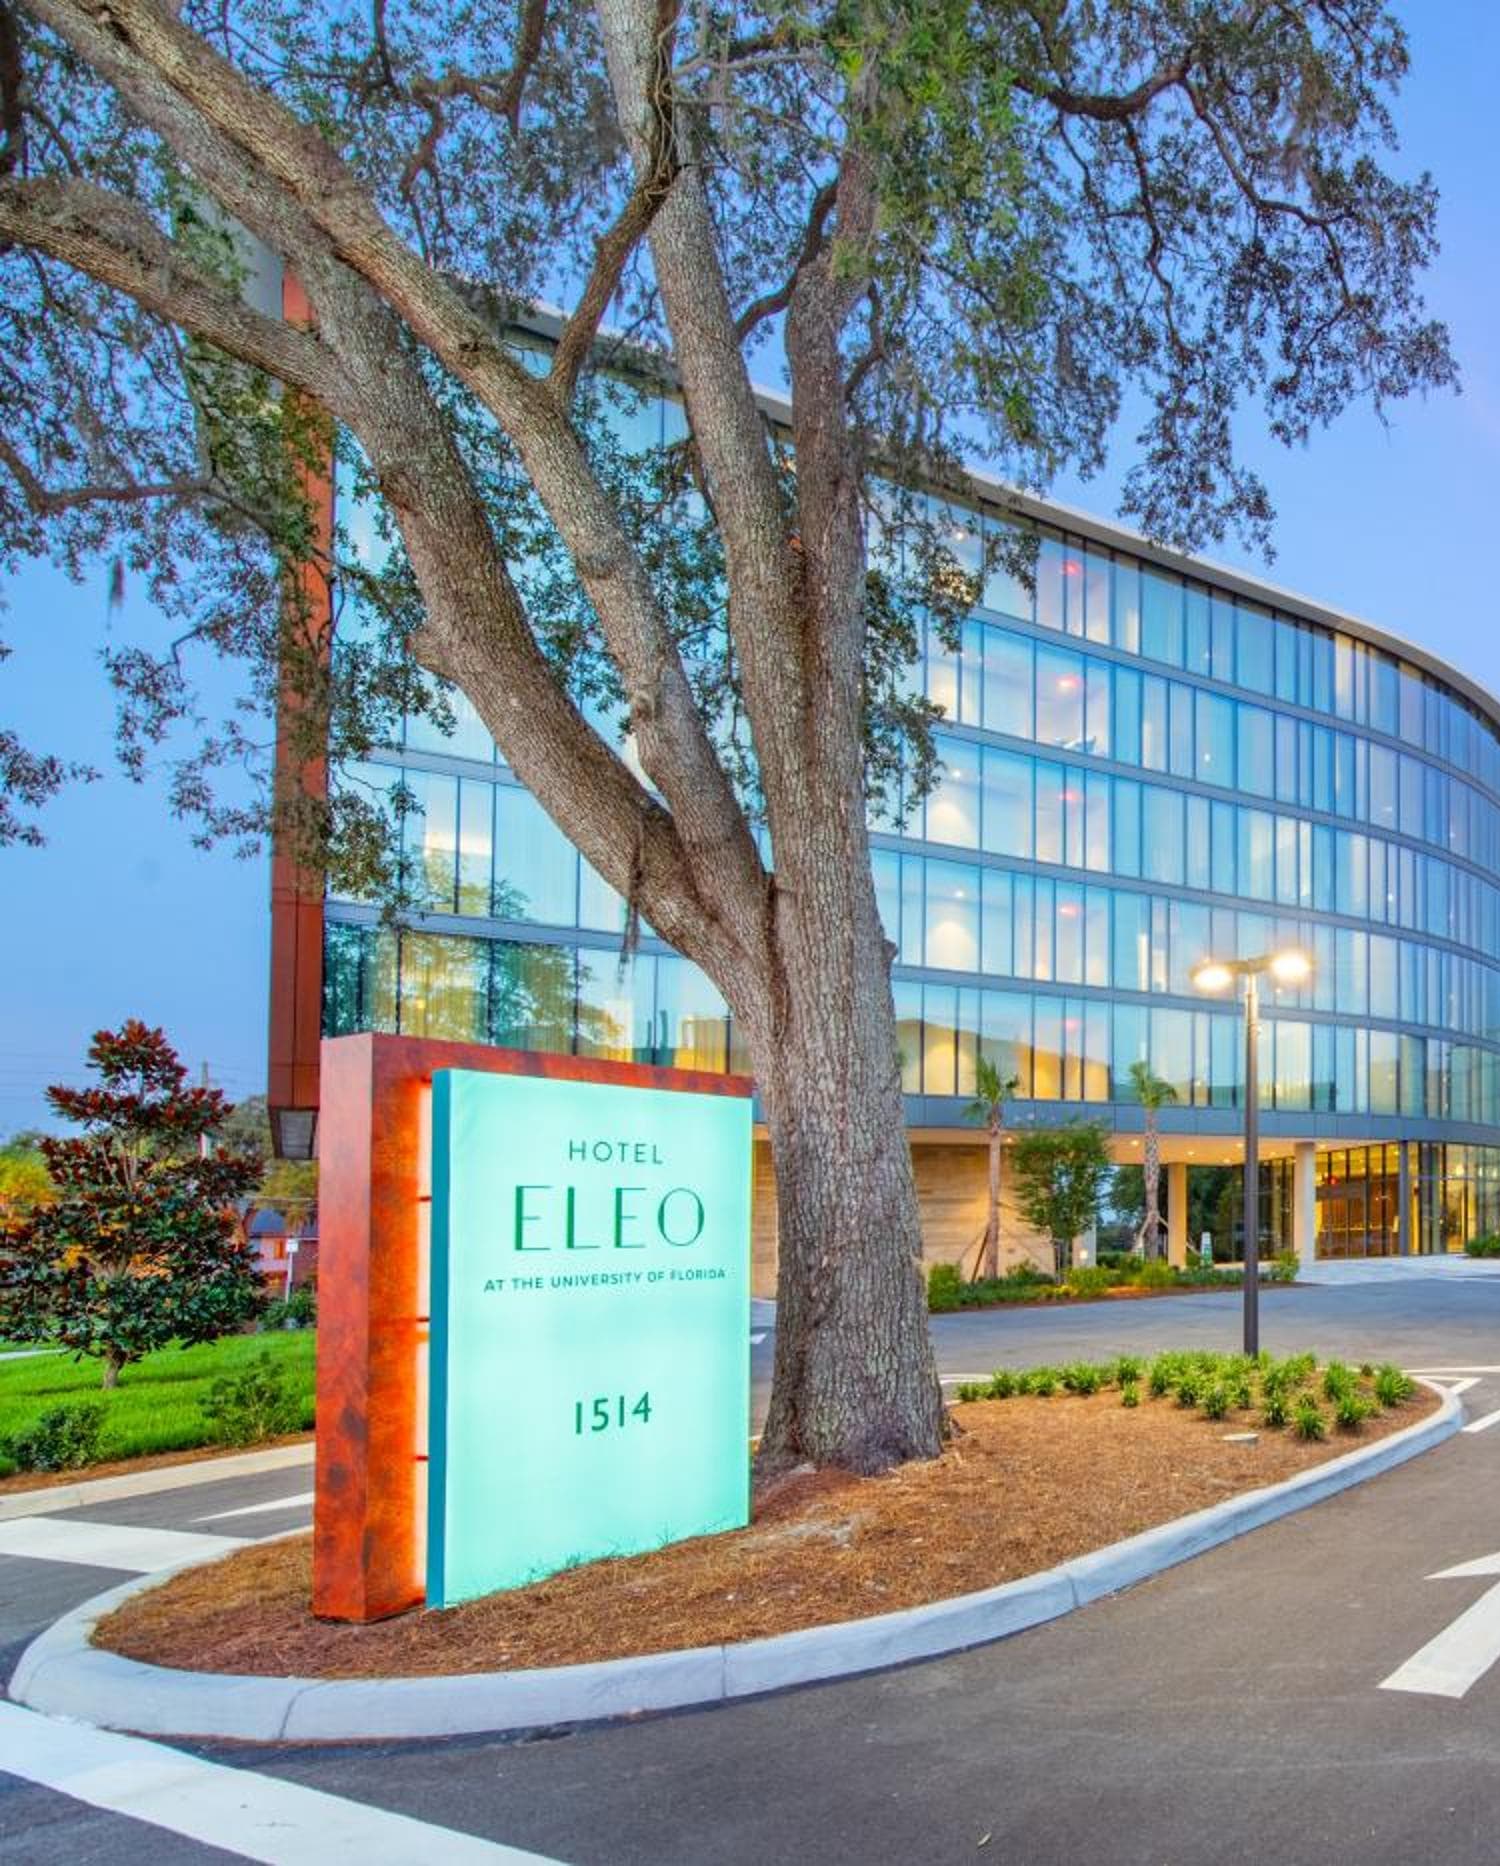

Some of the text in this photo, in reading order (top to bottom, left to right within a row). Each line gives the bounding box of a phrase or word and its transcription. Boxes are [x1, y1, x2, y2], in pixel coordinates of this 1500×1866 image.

[568, 1139, 663, 1165] HOTEL
[513, 1184, 706, 1251] ELEO
[483, 1267, 726, 1293] AT THE UNIVERSITY OF FLORIDA
[575, 1391, 653, 1435] 1514
